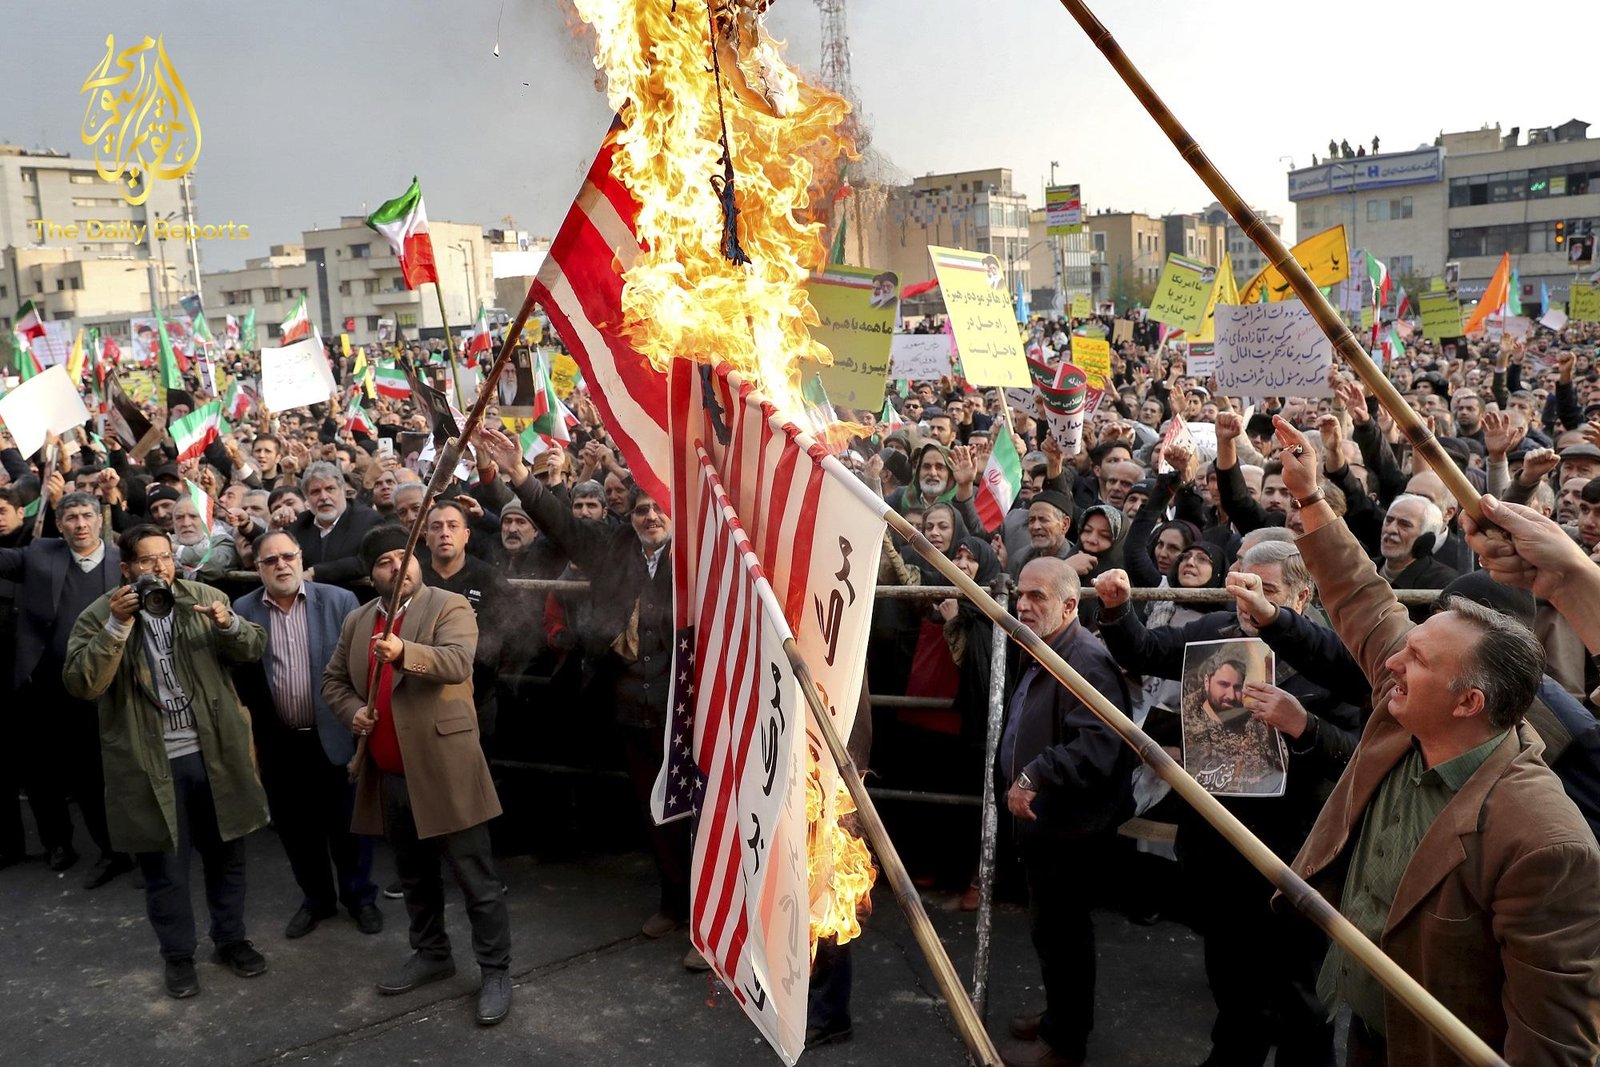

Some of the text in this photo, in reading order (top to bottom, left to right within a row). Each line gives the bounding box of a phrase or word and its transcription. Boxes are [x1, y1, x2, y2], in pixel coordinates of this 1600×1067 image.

[814, 535, 856, 667] مرگ
[760, 661, 787, 797] مرگ
[746, 811, 765, 877] بر
